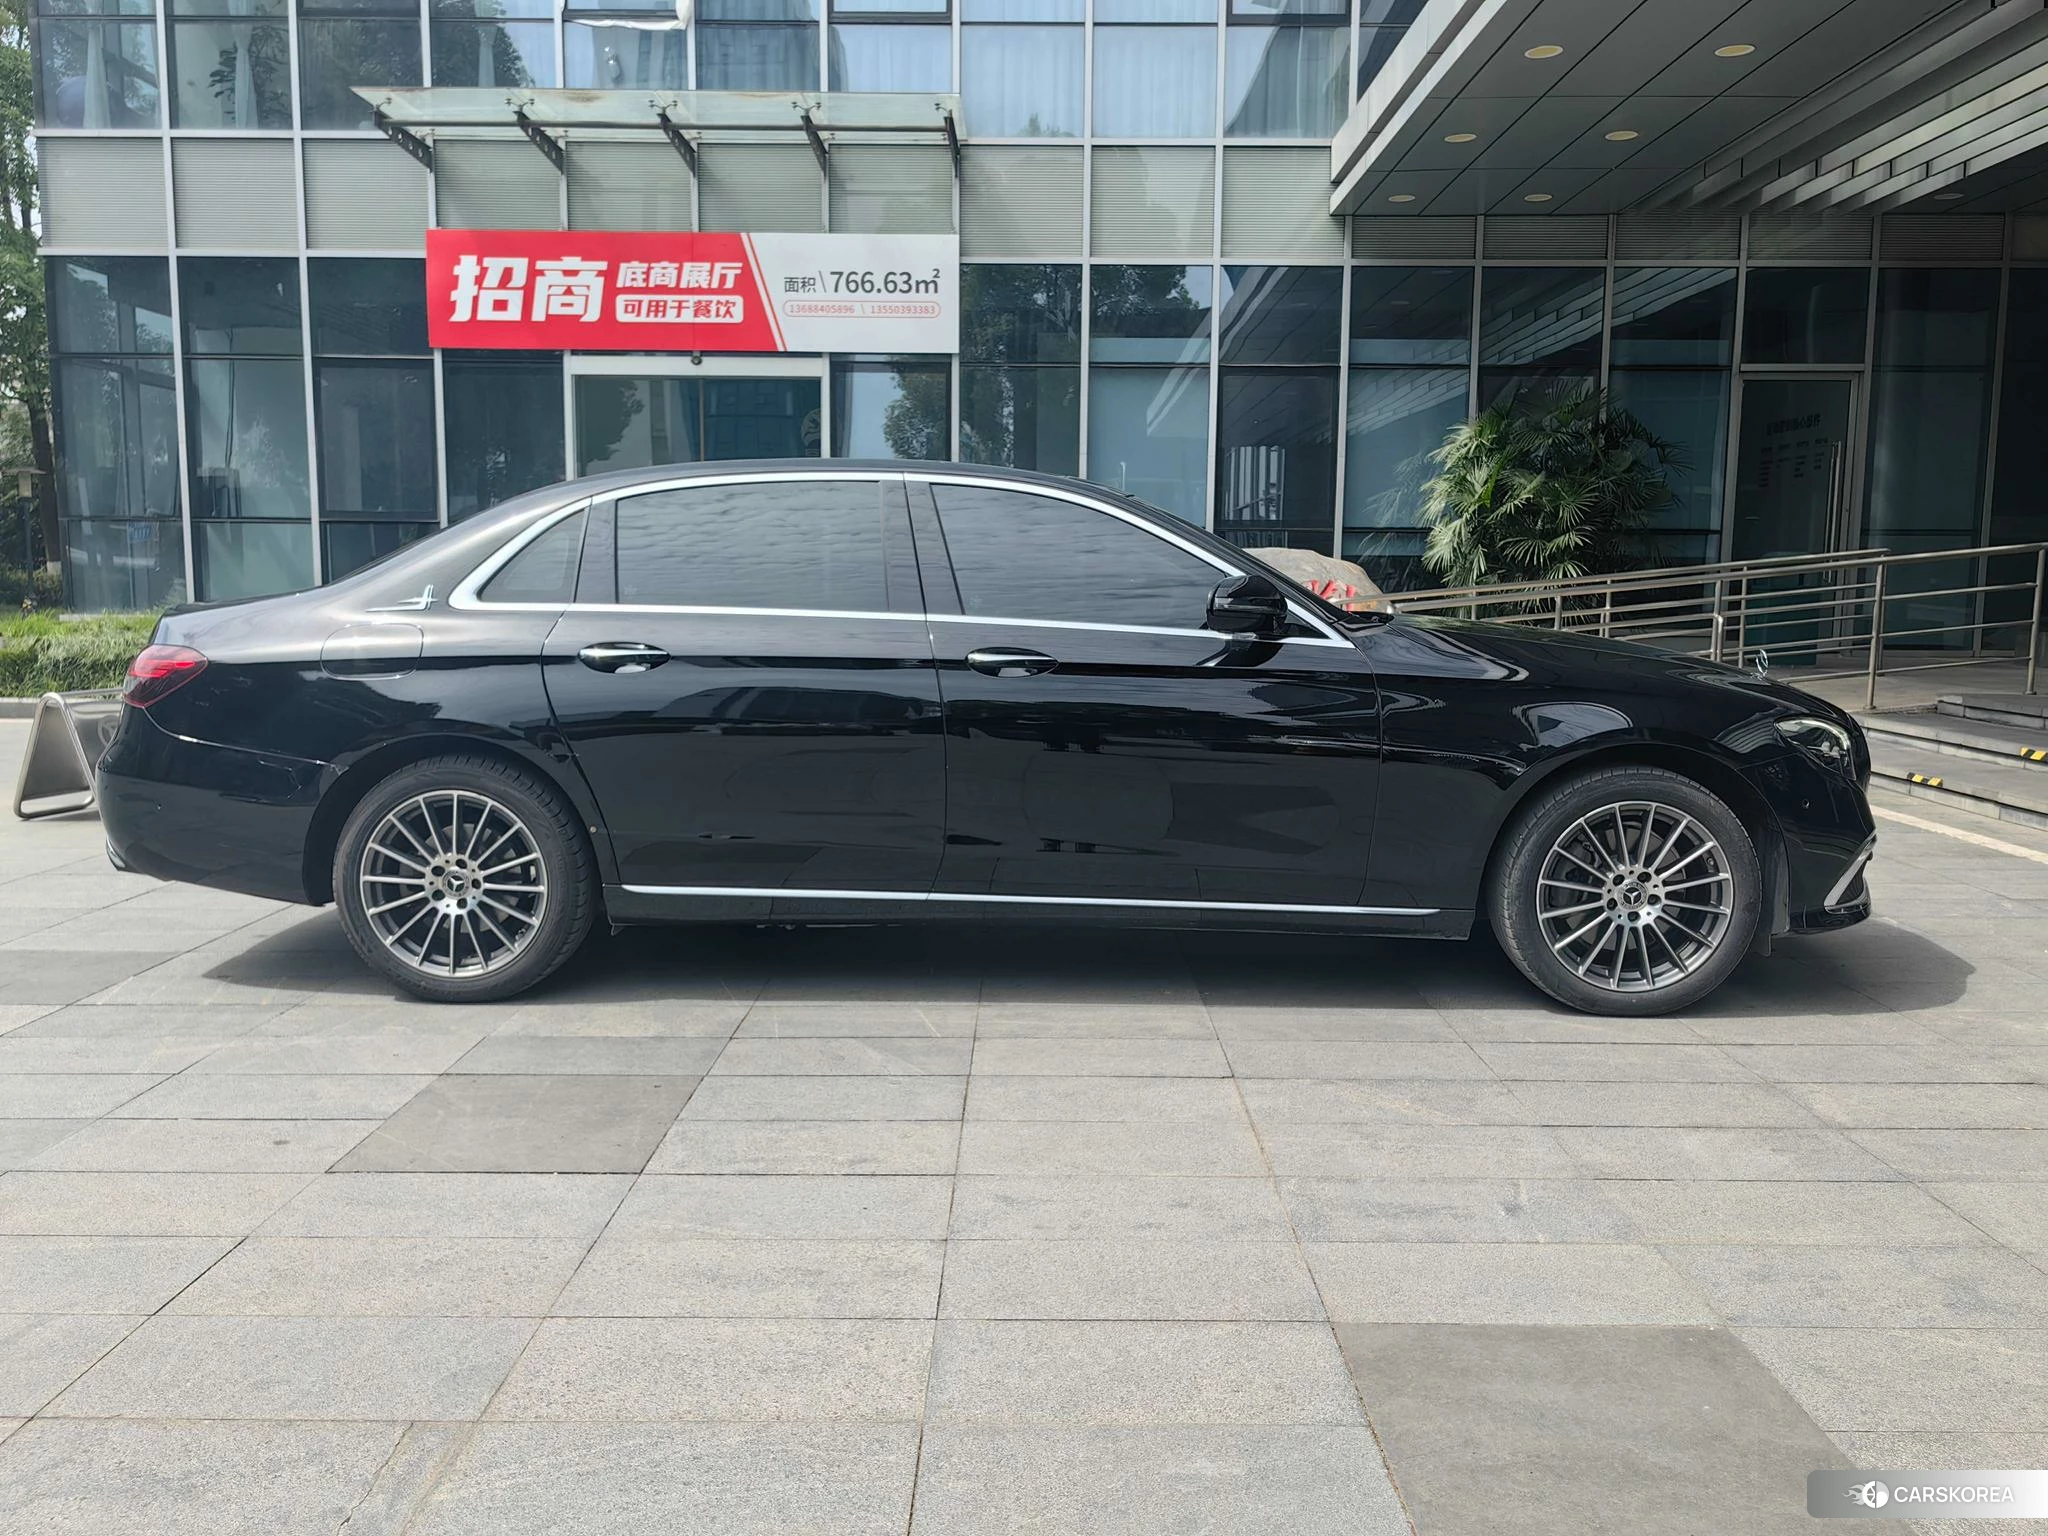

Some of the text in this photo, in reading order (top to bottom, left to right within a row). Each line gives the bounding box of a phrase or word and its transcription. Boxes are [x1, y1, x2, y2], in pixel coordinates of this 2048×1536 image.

[616, 261, 743, 289] 底商展厅
[784, 276, 816, 293] 面积
[449, 255, 608, 322] 招商
[622, 299, 737, 319] 可用于餐饮
